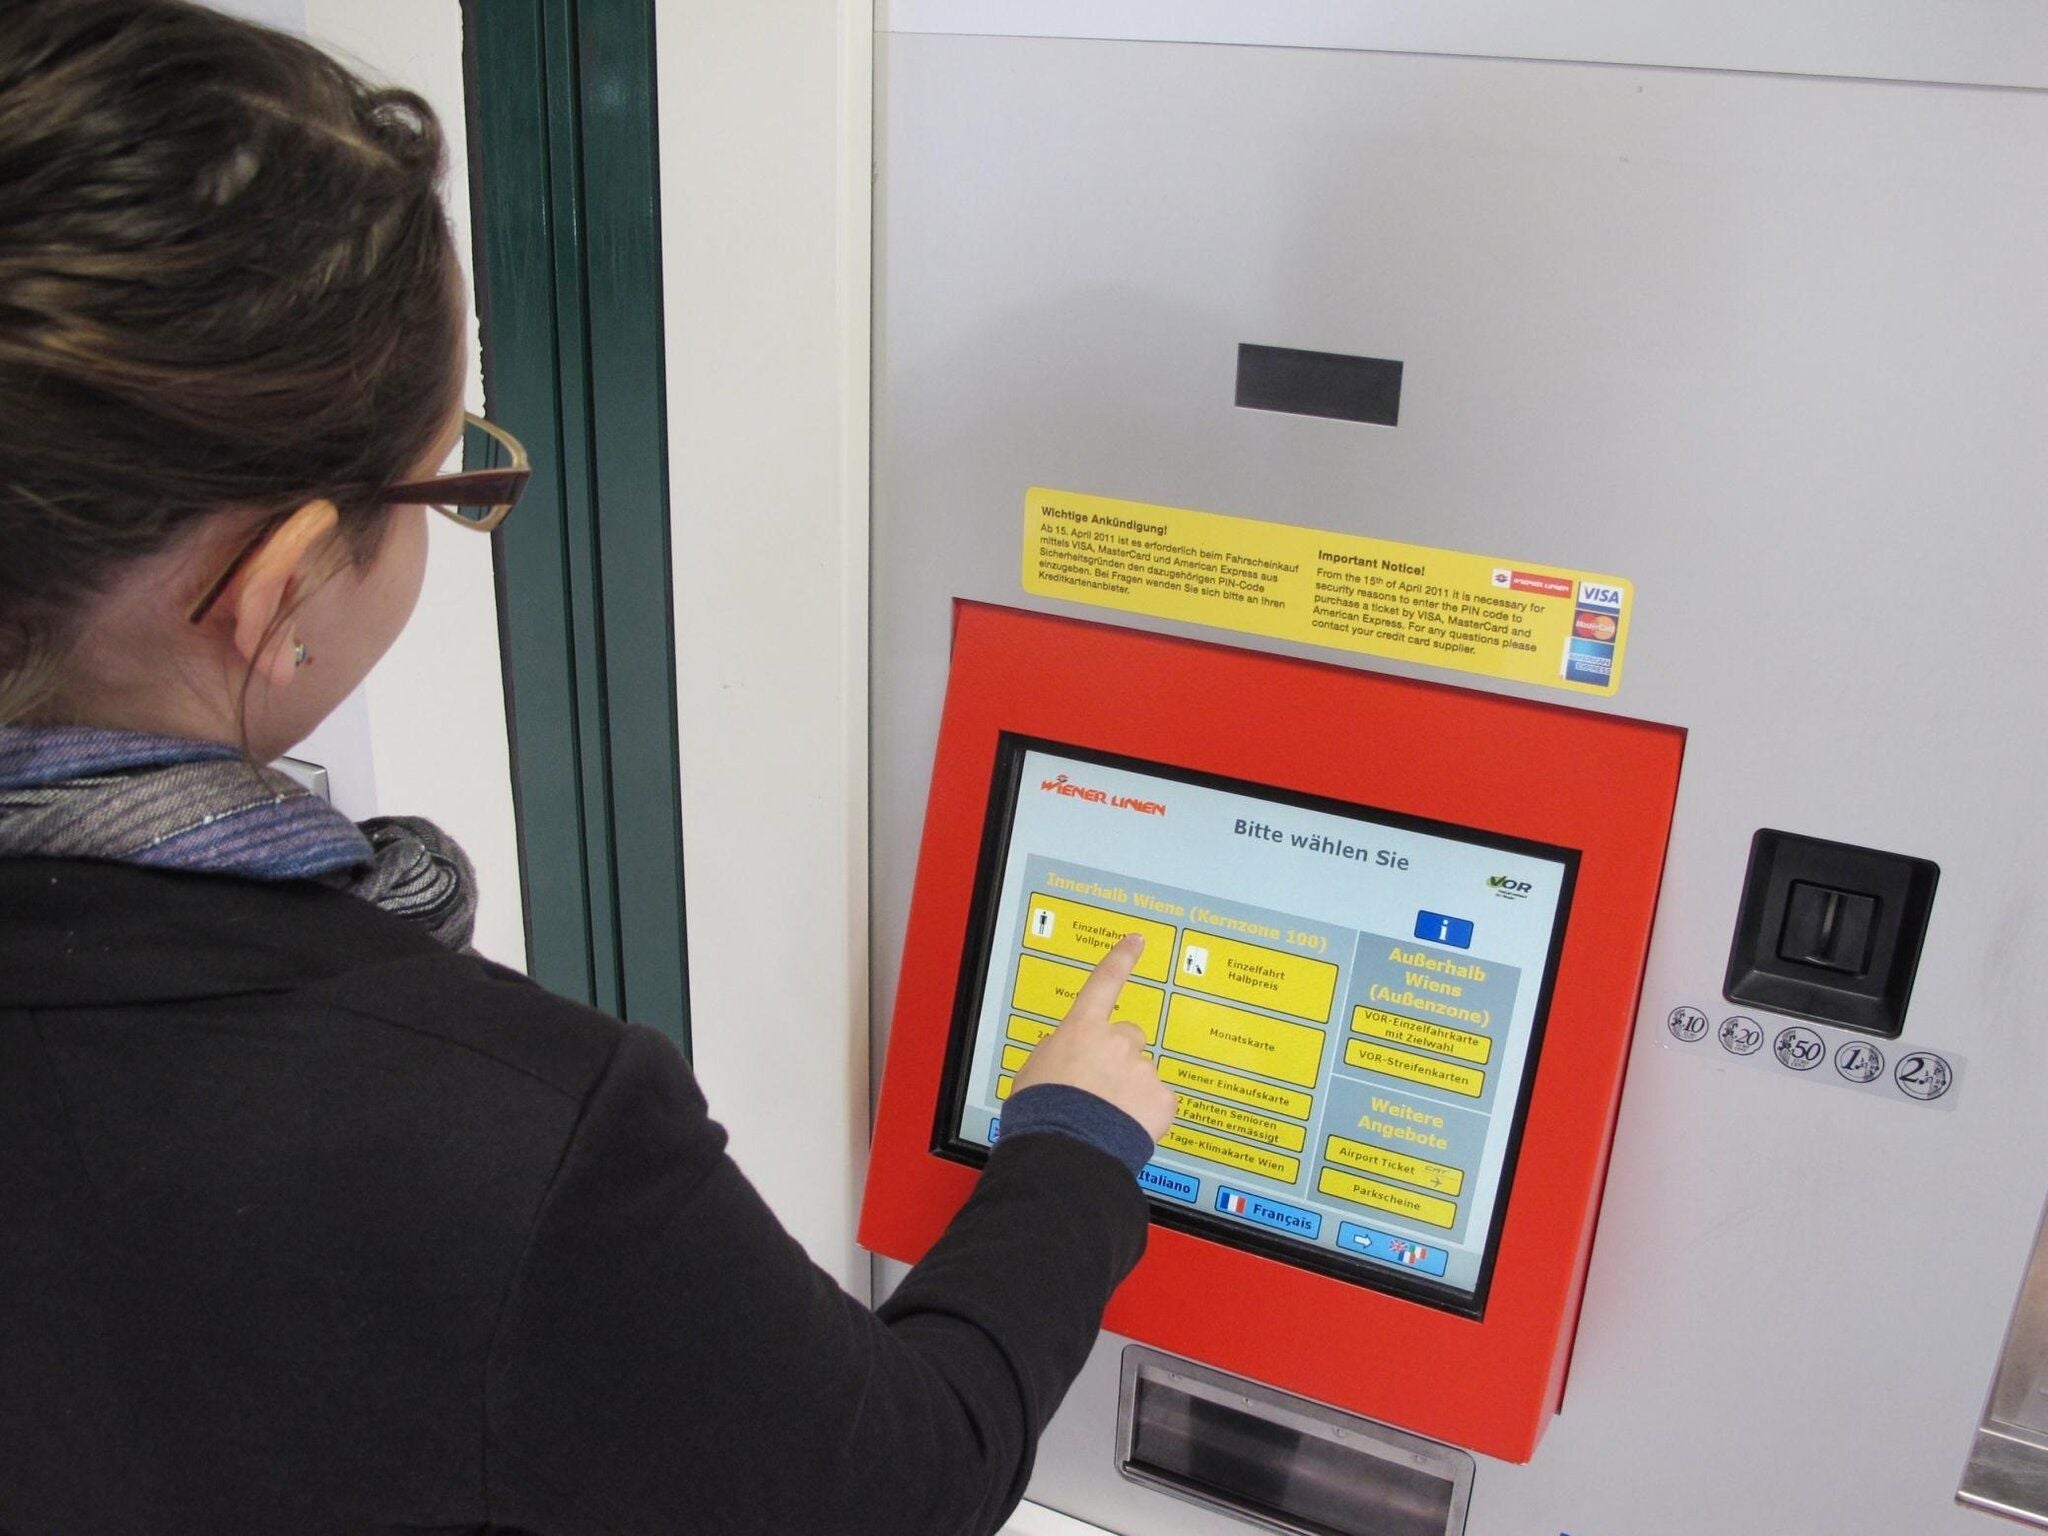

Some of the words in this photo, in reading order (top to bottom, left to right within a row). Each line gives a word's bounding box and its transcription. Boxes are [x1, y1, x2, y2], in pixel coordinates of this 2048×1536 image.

[1041, 506, 1088, 523] Wichtige
[1091, 514, 1167, 536] Ankündigung!
[1040, 523, 1053, 533] Ab
[1056, 526, 1068, 536] 15.
[1071, 529, 1091, 541] April
[1094, 532, 1114, 543] 2011
[1118, 535, 1129, 545] ist
[1144, 541, 1197, 557] erforderlich
[1200, 549, 1222, 561] beim
[1225, 553, 1299, 573] Fahrscheinkauf
[1040, 536, 1070, 548] mittels
[1072, 540, 1095, 553] VISA,
[1098, 545, 1151, 561] MasterCard
[1153, 554, 1171, 565] und
[1173, 557, 1217, 572] American
[1220, 565, 1258, 579] Express
[1261, 572, 1278, 582] aus
[1318, 550, 1378, 569] Important
[1381, 560, 1425, 576] Notice!
[1038, 570, 1130, 594] Kreditkartenanbieter.
[1039, 547, 1125, 569] Sicherheitsgründen
[1127, 562, 1145, 572] den
[1147, 565, 1215, 584] dazugehörigen
[1218, 577, 1265, 593] PIN-Code
[1039, 560, 1092, 576] einzugeben.
[1094, 568, 1109, 579] Bei
[1111, 571, 1143, 584] Fragen
[1145, 576, 1182, 590] wenden
[1184, 583, 1199, 594] Sie
[1201, 587, 1221, 598] sich
[1223, 590, 1245, 602] bitte
[1247, 595, 1258, 604] an
[1261, 596, 1285, 609] Ihren
[1315, 582, 1355, 597] security
[1357, 589, 1397, 602] reasons
[1399, 595, 1410, 604] to
[1412, 598, 1439, 609] enter
[1442, 602, 1458, 612] the
[1461, 604, 1480, 616] PIN
[1483, 609, 1509, 620] code
[1512, 614, 1523, 623] to
[1316, 567, 1342, 580] From
[1345, 573, 1361, 583] the
[1386, 580, 1396, 588] of
[1398, 581, 1423, 593] April
[1425, 586, 1448, 597] 2011
[1452, 590, 1460, 599] it
[1462, 592, 1470, 601] is
[1473, 595, 1527, 612] necessary
[1530, 603, 1546, 613] for
[1584, 586, 1620, 604] VISA
[1312, 605, 1360, 621] American
[1362, 613, 1404, 629] Express.
[1408, 621, 1426, 632] For
[1428, 626, 1446, 638] any
[1449, 630, 1500, 646] questions
[1502, 638, 1537, 652] please
[1314, 595, 1360, 609] purchase
[1372, 603, 1399, 616] ticket
[1402, 608, 1415, 619] by
[1417, 610, 1444, 624] VISA,
[1448, 615, 1509, 634] MasterCard
[1511, 627, 1531, 638] and
[1311, 619, 1349, 632] contact
[1352, 626, 1374, 636] your
[1376, 630, 1405, 642] credit
[1407, 636, 1430, 646] card
[1433, 639, 1476, 654] supplier.
[1041, 780, 1107, 804] WIENER
[1111, 795, 1167, 816] LINIEN
[1234, 819, 1283, 843] Bitte
[1290, 834, 1368, 862] wählen
[1375, 849, 1410, 871] Sie
[1490, 875, 1532, 893] VOR
[1047, 871, 1127, 904] Innerhalb
[1190, 906, 1281, 940] (Kernzone
[1286, 929, 1327, 953] 100)
[1227, 958, 1286, 980] Einzelfahrt
[1388, 947, 1487, 982] Außerhalb
[1228, 971, 1280, 991] Halbpreis
[1405, 971, 1463, 997] Wiens
[1369, 983, 1491, 1028] (Außenzone)
[1209, 1028, 1276, 1052] Monatskarte
[1364, 1010, 1479, 1046] VOR-Einzelfahrkarte
[1684, 1016, 1705, 1033] 10
[1735, 1028, 1760, 1046] 20
[1385, 1029, 1403, 1041] mit
[1406, 1034, 1454, 1053] Zielwahl
[1791, 1040, 1822, 1061] 50
[1359, 1049, 1469, 1085] VOR-Streifenkarten
[1841, 1049, 1861, 1070] 1
[1898, 1057, 1924, 1083] 2
[1178, 1069, 1214, 1086] Wiener
[1217, 1081, 1290, 1106] Einkaufskarte
[1183, 1110, 1223, 1128] Fahrten
[1226, 1121, 1279, 1145] ermässigt
[1187, 1099, 1227, 1117] Fahrten
[1230, 1110, 1277, 1130] Senioren
[1371, 1096, 1444, 1128] Weitere
[1358, 1115, 1448, 1150] Angebote
[1258, 1158, 1285, 1173] Wien
[1339, 1147, 1379, 1164] Airport
[1381, 1158, 1416, 1175] Ticket
[1138, 1170, 1191, 1194] Italiano
[1353, 1184, 1422, 1210] Parkscheine
[1253, 1203, 1312, 1230] Français
